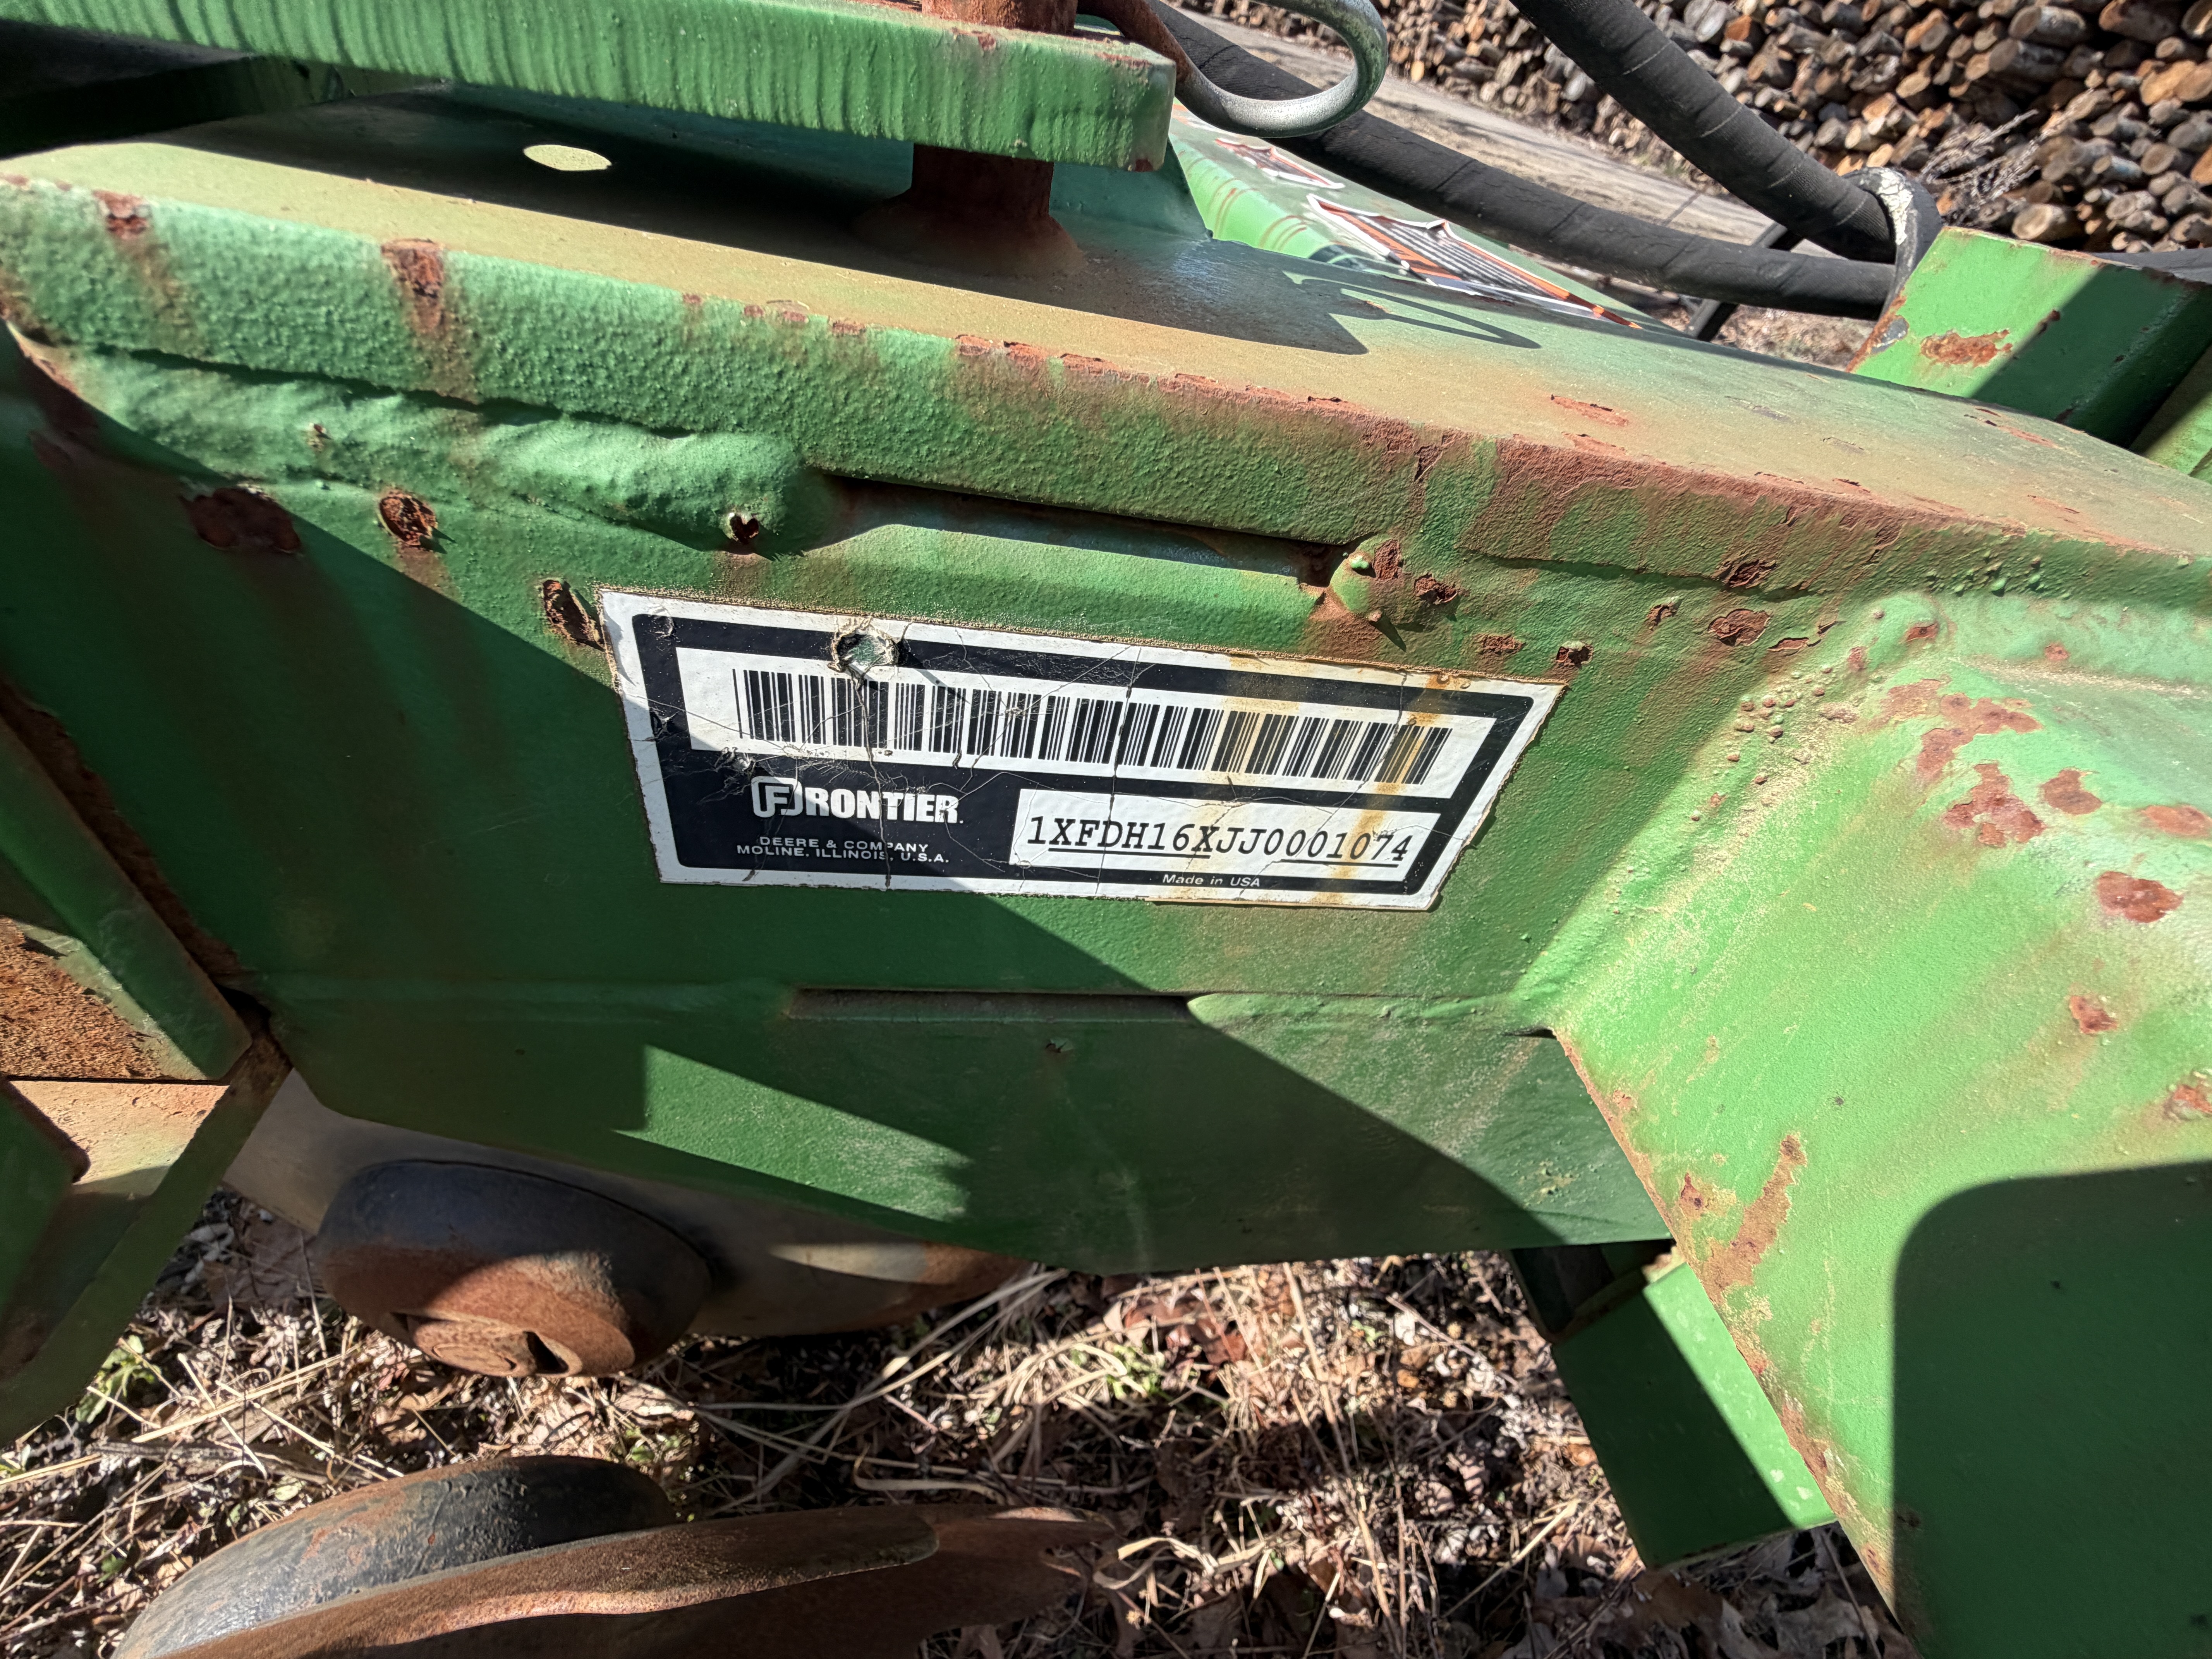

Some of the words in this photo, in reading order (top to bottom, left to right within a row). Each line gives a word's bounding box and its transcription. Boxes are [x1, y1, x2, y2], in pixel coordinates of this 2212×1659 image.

[760, 836, 819, 847] DEERE
[826, 840, 836, 848] &
[844, 841, 928, 852] COMPANY
[1027, 816, 1413, 861] 1XFDH16XJJ0001074
[901, 853, 949, 863] U.S.A.
[1163, 874, 1204, 884] Made
[1210, 876, 1223, 885] in
[1230, 877, 1260, 887] USA
